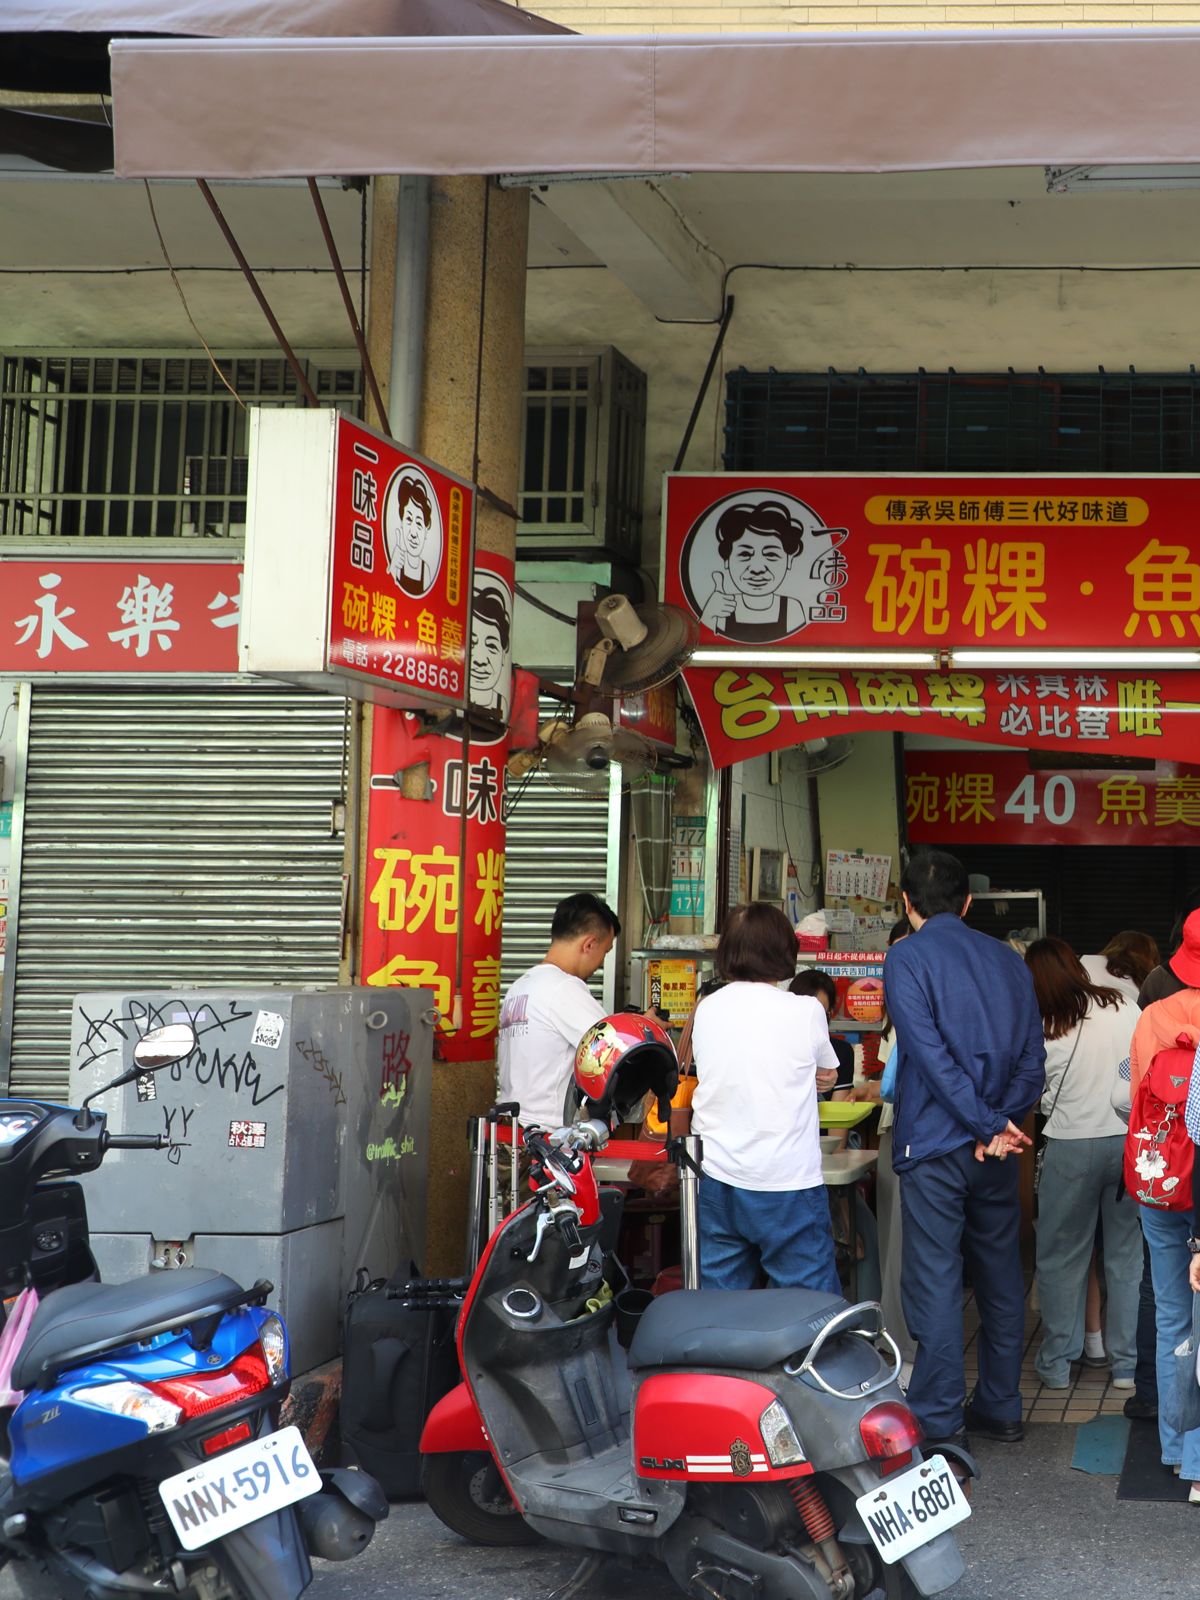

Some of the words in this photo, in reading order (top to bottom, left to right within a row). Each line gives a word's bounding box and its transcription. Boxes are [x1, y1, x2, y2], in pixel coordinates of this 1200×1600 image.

[350, 442, 378, 574] 一味品
[885, 499, 1129, 522] 傳承吳師傅三代好味道
[14, 573, 242, 658] 永樂
[713, 670, 986, 740] 台南碗粿
[996, 674, 1109, 702] 米其林
[1000, 703, 1110, 739] 必比登
[371, 757, 507, 825] 一味
[1004, 774, 1077, 825] 40
[868, 1472, 956, 1546] NHA-6887
